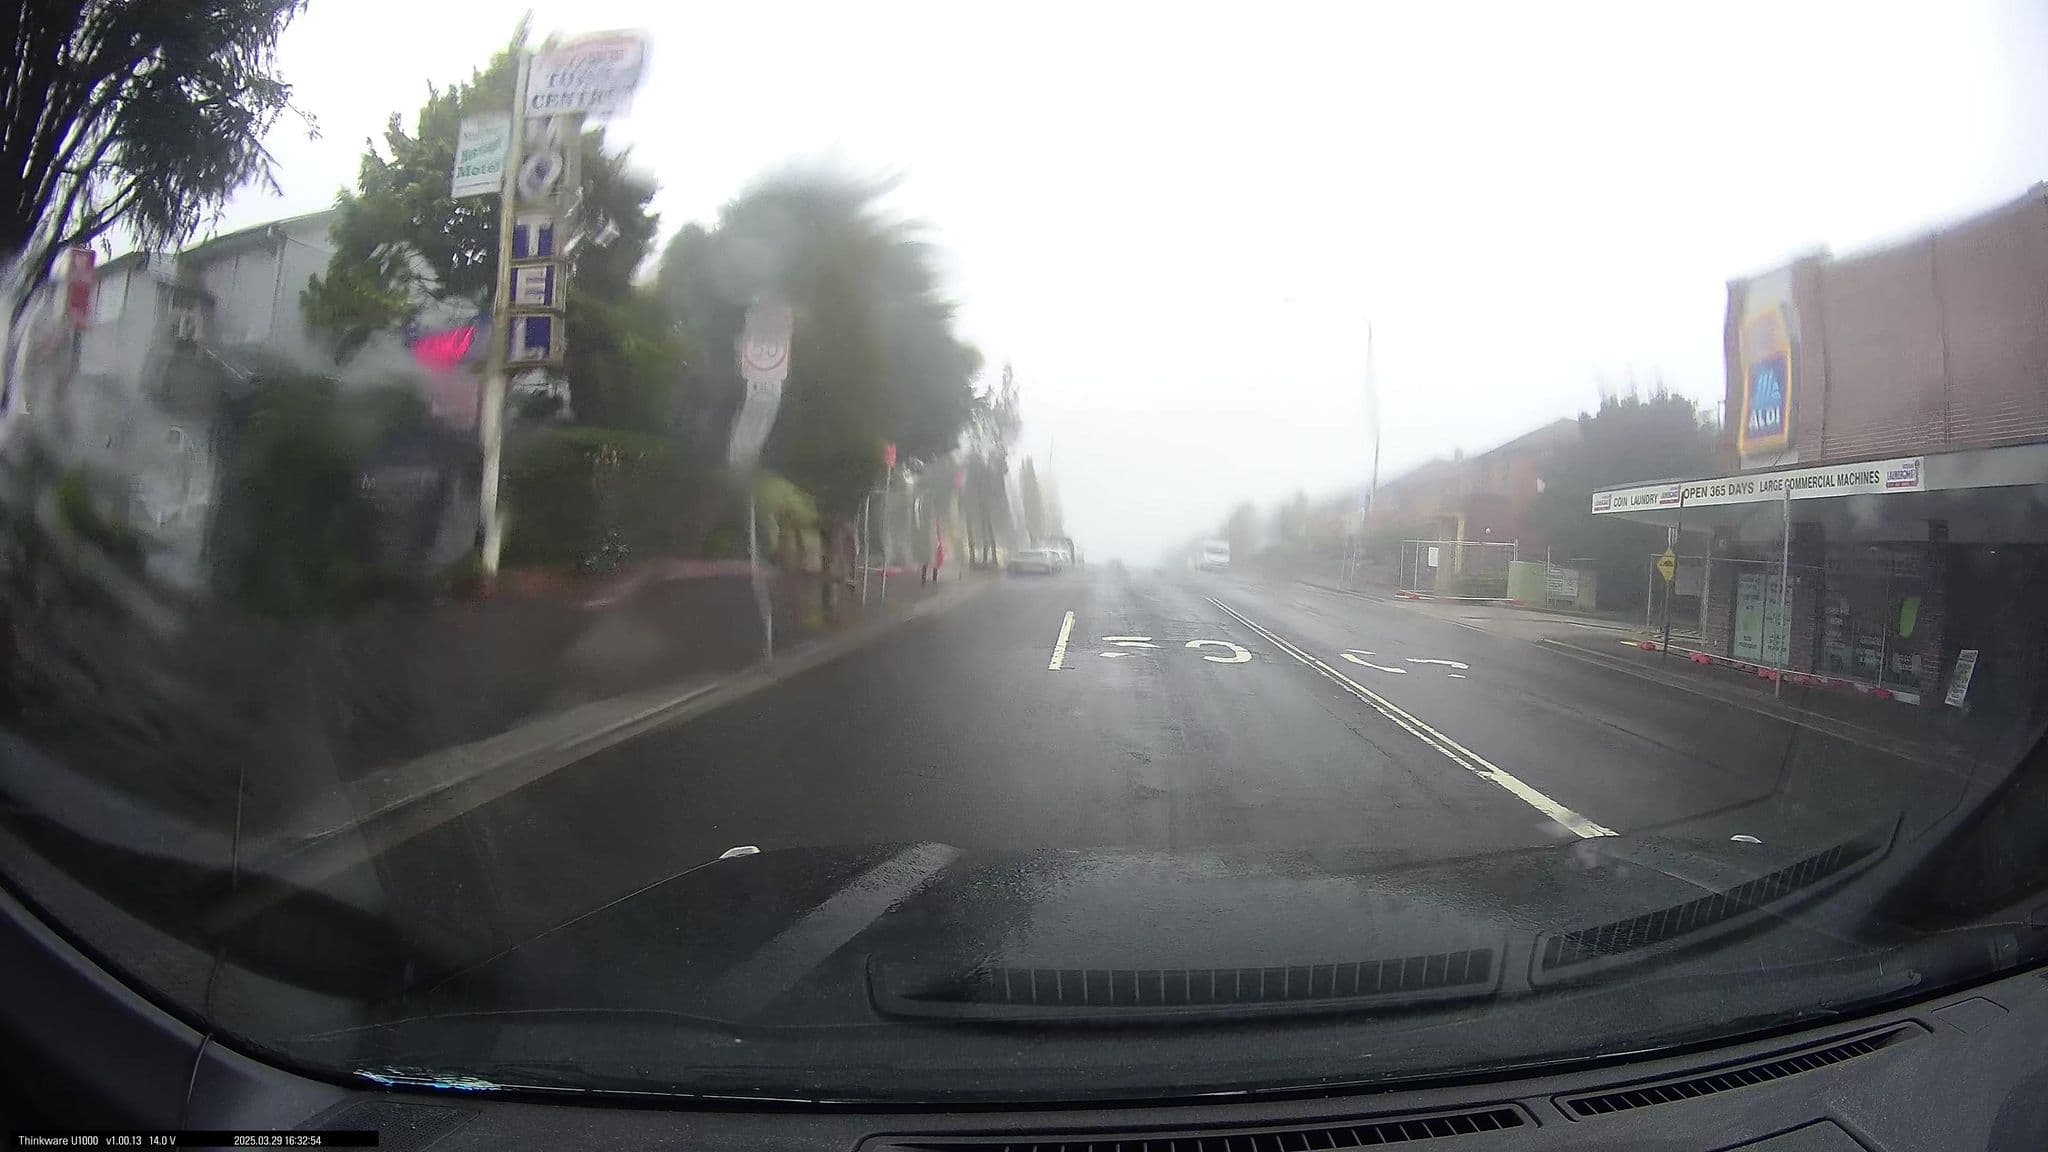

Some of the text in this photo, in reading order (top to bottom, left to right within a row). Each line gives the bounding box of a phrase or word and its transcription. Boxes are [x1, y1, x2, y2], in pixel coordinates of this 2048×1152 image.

[1749, 405, 1780, 431] ALDI
[1684, 488, 1708, 500] OPEN
[1710, 485, 1726, 498] 365
[1728, 482, 1754, 495] DAYS
[1759, 479, 1783, 493] LARGE
[1784, 474, 1835, 490] COMMERCIAL
[1837, 470, 1880, 487] MACHINES
[1613, 496, 1628, 508] COIN
[1631, 493, 1658, 506] LAUNDRY
